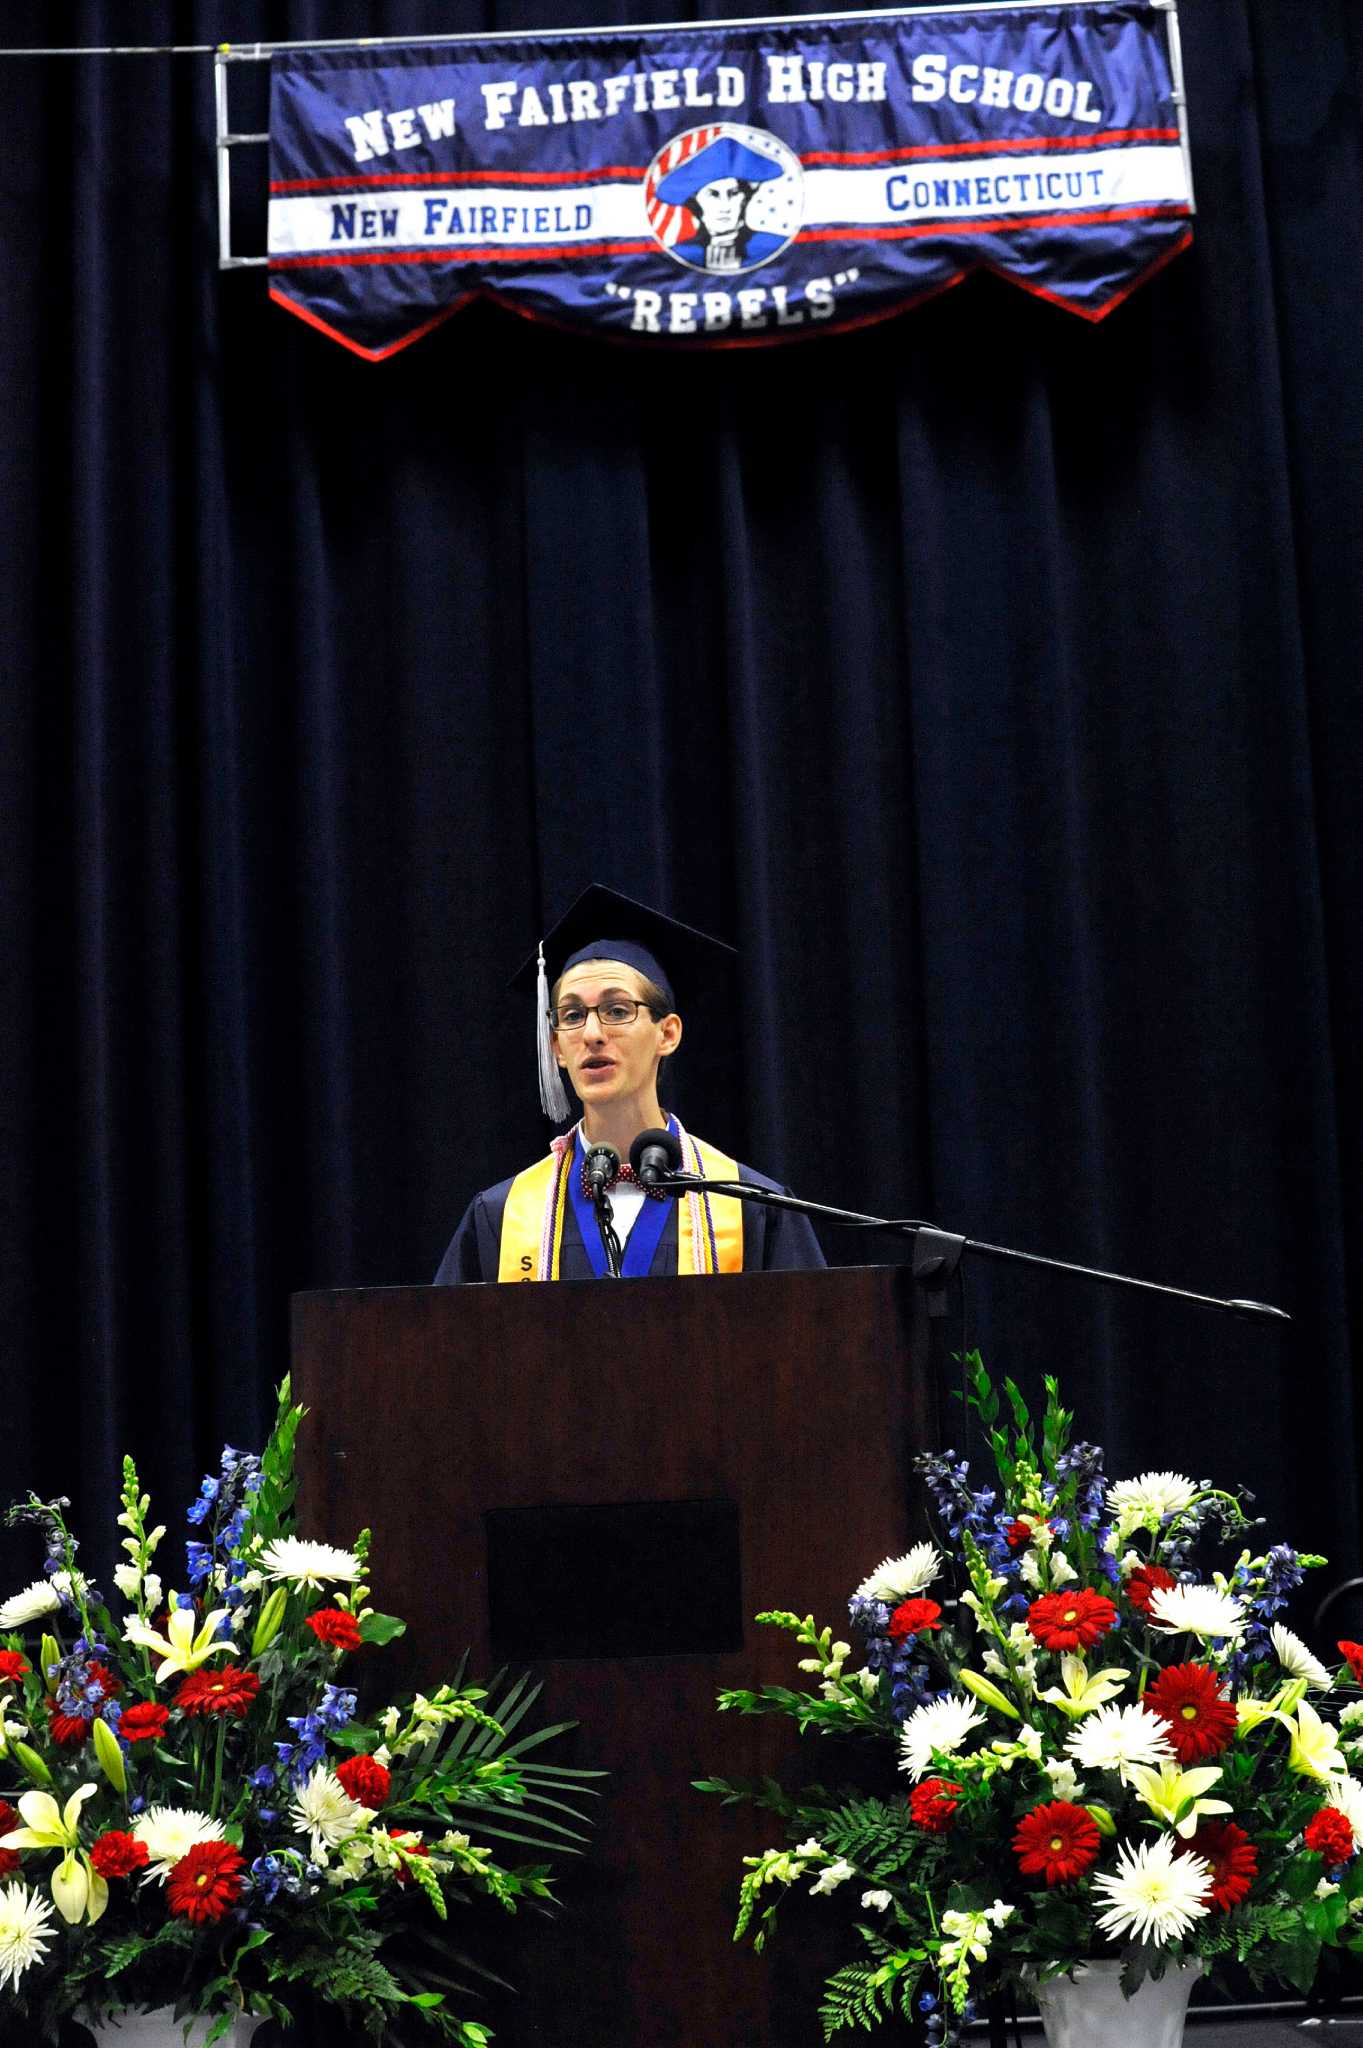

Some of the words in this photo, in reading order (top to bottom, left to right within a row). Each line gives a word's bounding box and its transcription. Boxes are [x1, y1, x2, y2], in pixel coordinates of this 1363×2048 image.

[345, 100, 456, 162] NEW
[482, 67, 745, 130] FAIRFIELD
[767, 55, 886, 103] HIGH
[911, 53, 1102, 124] SCHOOL
[885, 168, 1104, 213] CONNECTICUT
[330, 202, 400, 241] NEW
[423, 199, 592, 236] FAIRFIELD
